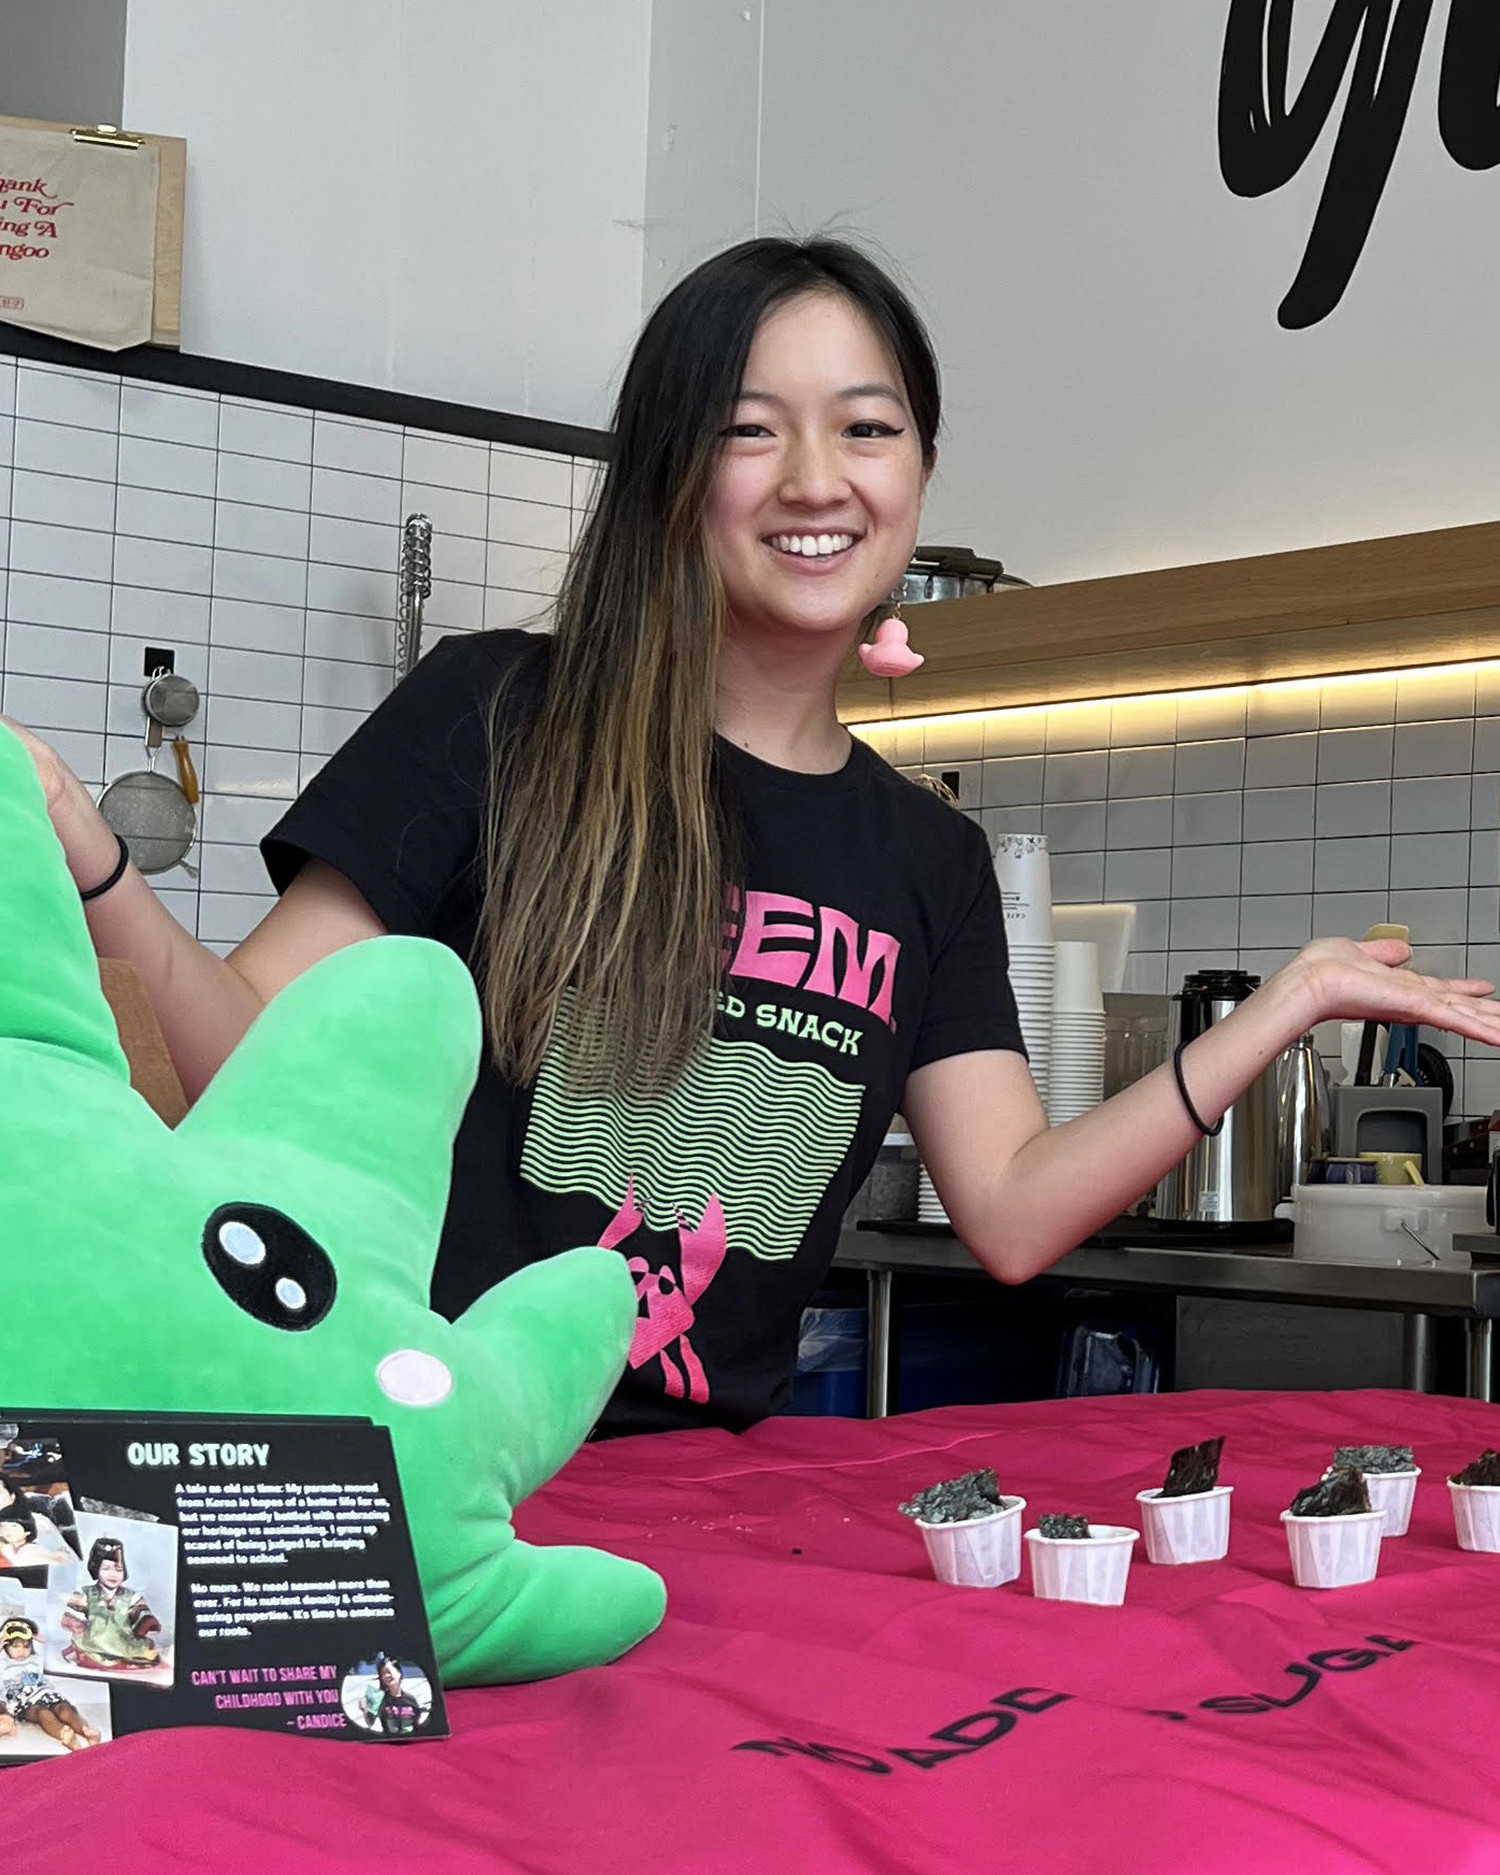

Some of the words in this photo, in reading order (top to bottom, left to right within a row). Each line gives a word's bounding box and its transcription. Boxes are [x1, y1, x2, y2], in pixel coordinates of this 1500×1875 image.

[14, 196, 75, 215] For
[0, 216, 31, 237] ing
[34, 220, 57, 238] A
[0, 243, 49, 260] ngoo
[756, 1004, 864, 1056] SNACK
[127, 1442, 180, 1466] OUR
[189, 1443, 270, 1466] STORY
[175, 1483, 185, 1493] A
[303, 1483, 343, 1495] parents
[176, 1497, 204, 1507] from
[205, 1497, 238, 1507] Korea
[179, 1511, 198, 1522] but
[200, 1513, 216, 1521] we
[217, 1511, 273, 1523] constantly
[312, 1510, 335, 1520] with
[336, 1510, 390, 1522] embracing
[202, 1525, 247, 1537] heritage
[336, 1526, 362, 1536] grew
[184, 1539, 222, 1550] scared
[236, 1539, 267, 1551] being
[267, 1538, 304, 1551] judged
[305, 1538, 321, 1548] for
[321, 1537, 366, 1550] bringing
[186, 1553, 235, 1564] seaweed
[235, 1554, 248, 1564] to
[190, 1582, 208, 1593] No
[242, 1582, 261, 1592] We
[262, 1581, 289, 1592] need
[290, 1580, 337, 1591] seaweed
[337, 1581, 365, 1590] more
[366, 1579, 390, 1588] than
[222, 1597, 242, 1607] For
[259, 1595, 302, 1606] nutrient
[302, 1594, 341, 1606] density
[196, 1612, 233, 1624] saving
[310, 1608, 335, 1619] time
[335, 1608, 349, 1618] to
[349, 1606, 395, 1618] embrace
[198, 1628, 217, 1637] our
[191, 1670, 226, 1686] CAN'T
[229, 1668, 259, 1684] WAIT
[261, 1667, 277, 1682] TO
[279, 1666, 317, 1682] SHARE
[319, 1665, 337, 1680] MY
[215, 1692, 282, 1710] CHILDHOOD
[283, 1690, 314, 1706] WITH
[315, 1689, 339, 1704] YOU
[296, 1713, 347, 1730] CANDICE
